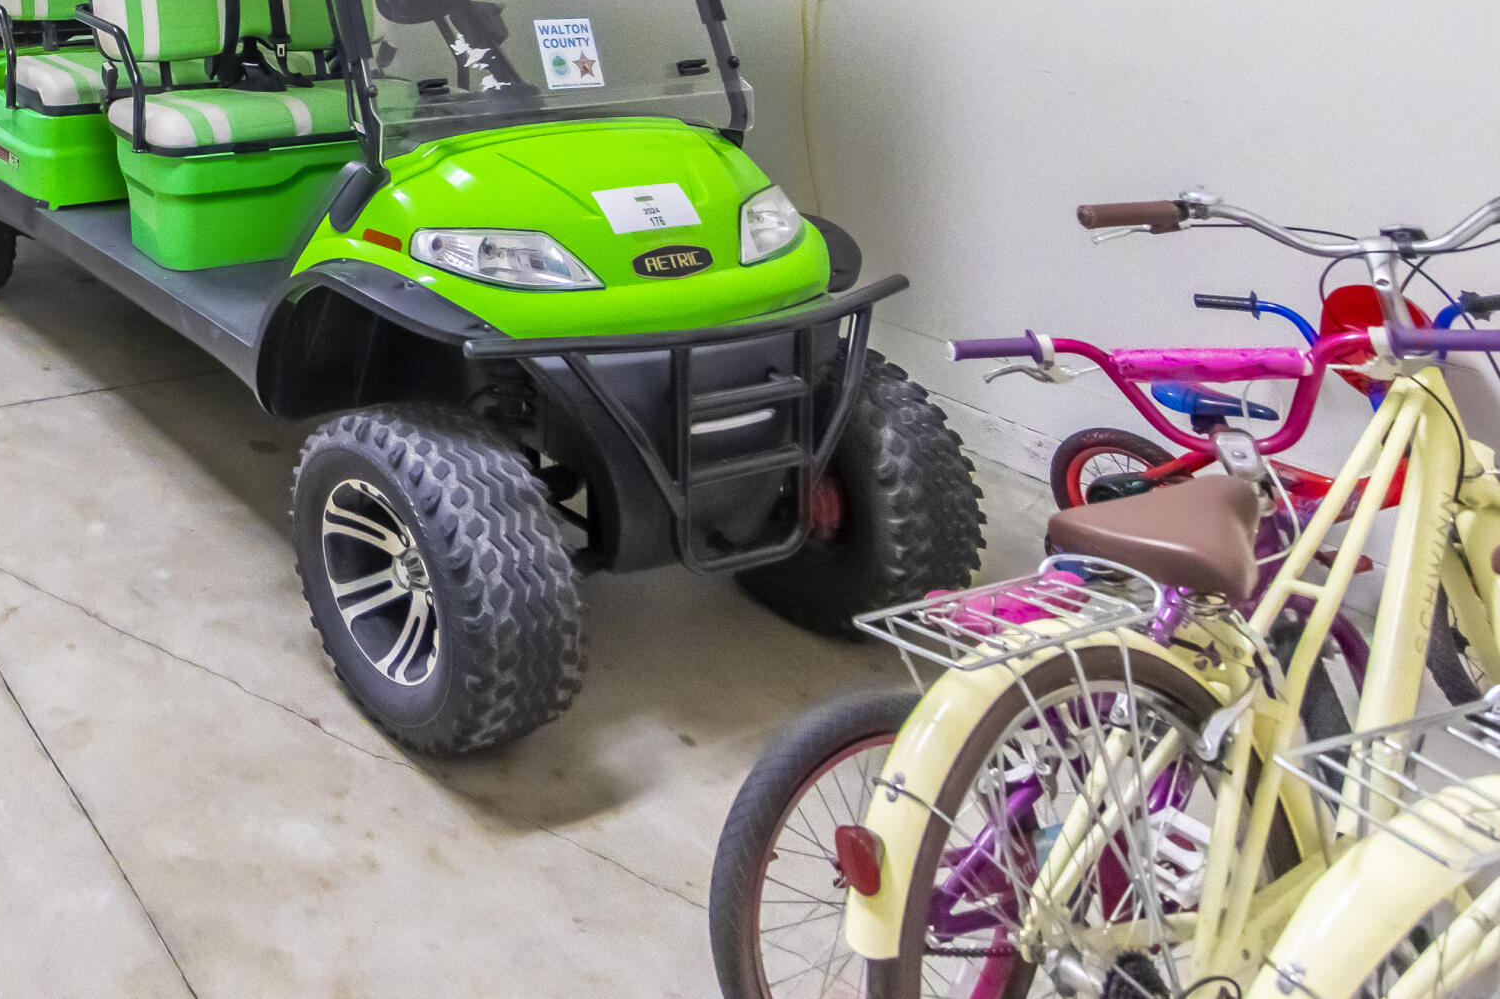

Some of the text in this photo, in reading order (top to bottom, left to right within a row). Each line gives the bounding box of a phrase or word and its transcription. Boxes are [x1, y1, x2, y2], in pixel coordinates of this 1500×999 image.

[538, 23, 589, 35] WALTON
[543, 37, 590, 48] COUNTY
[650, 216, 666, 226] 176
[644, 251, 704, 273] AETRIC
